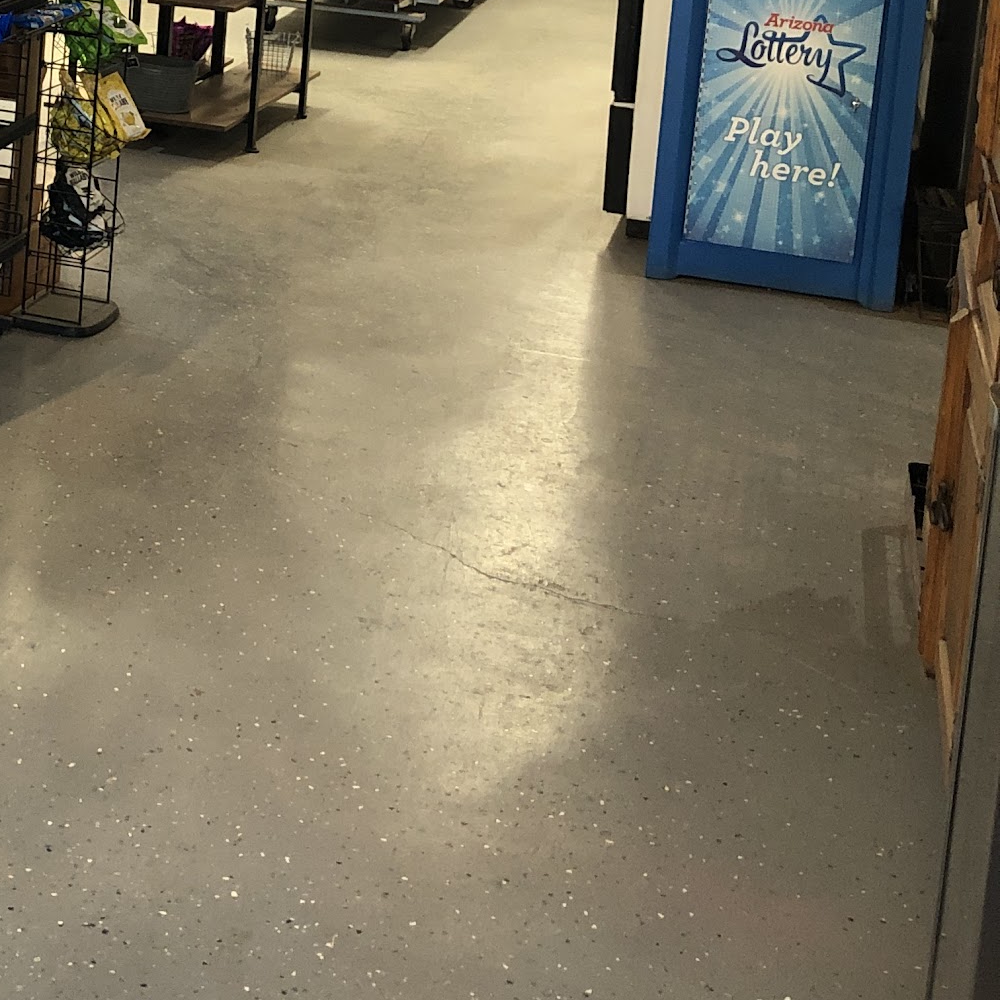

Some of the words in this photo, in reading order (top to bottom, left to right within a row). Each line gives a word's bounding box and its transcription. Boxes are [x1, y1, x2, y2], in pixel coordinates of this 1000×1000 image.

[764, 13, 834, 34] Arizona
[716, 21, 833, 87] Lottery
[724, 116, 802, 155] Play
[749, 150, 842, 187] here!
